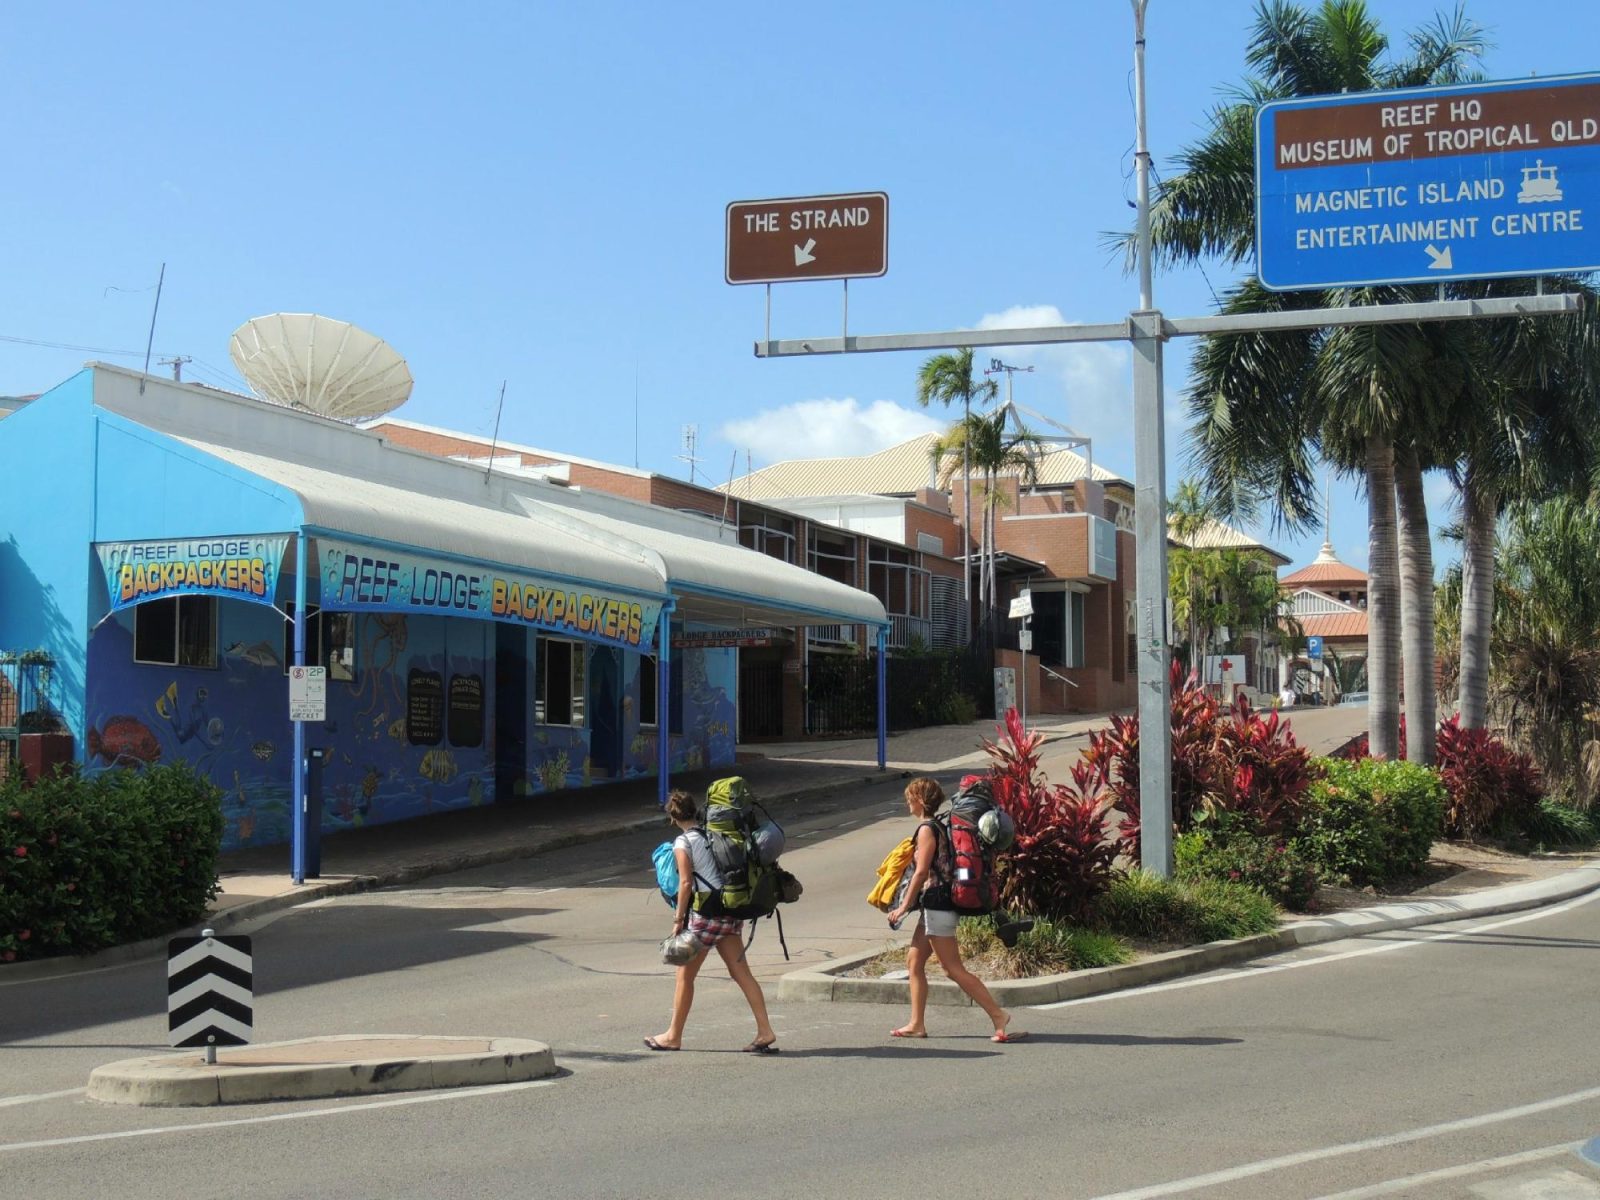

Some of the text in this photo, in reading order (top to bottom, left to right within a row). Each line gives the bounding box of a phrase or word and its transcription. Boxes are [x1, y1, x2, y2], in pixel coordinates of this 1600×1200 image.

[1381, 99, 1482, 128] REEF HQ
[1280, 118, 1598, 165] MUSEUM OF TROPICAL QLD
[1295, 178, 1505, 214] MAGNETIC ISLAND
[744, 207, 870, 233] THE STRAND
[1296, 209, 1584, 250] ENTERTAINMENT CENTRE
[133, 541, 250, 560] REEF LODGE
[120, 557, 267, 602] BACKPACKERS
[339, 554, 643, 647] REEF LODGE BACKPACKERS
[1310, 639, 1318, 652] P
[309, 667, 323, 676] 2P
